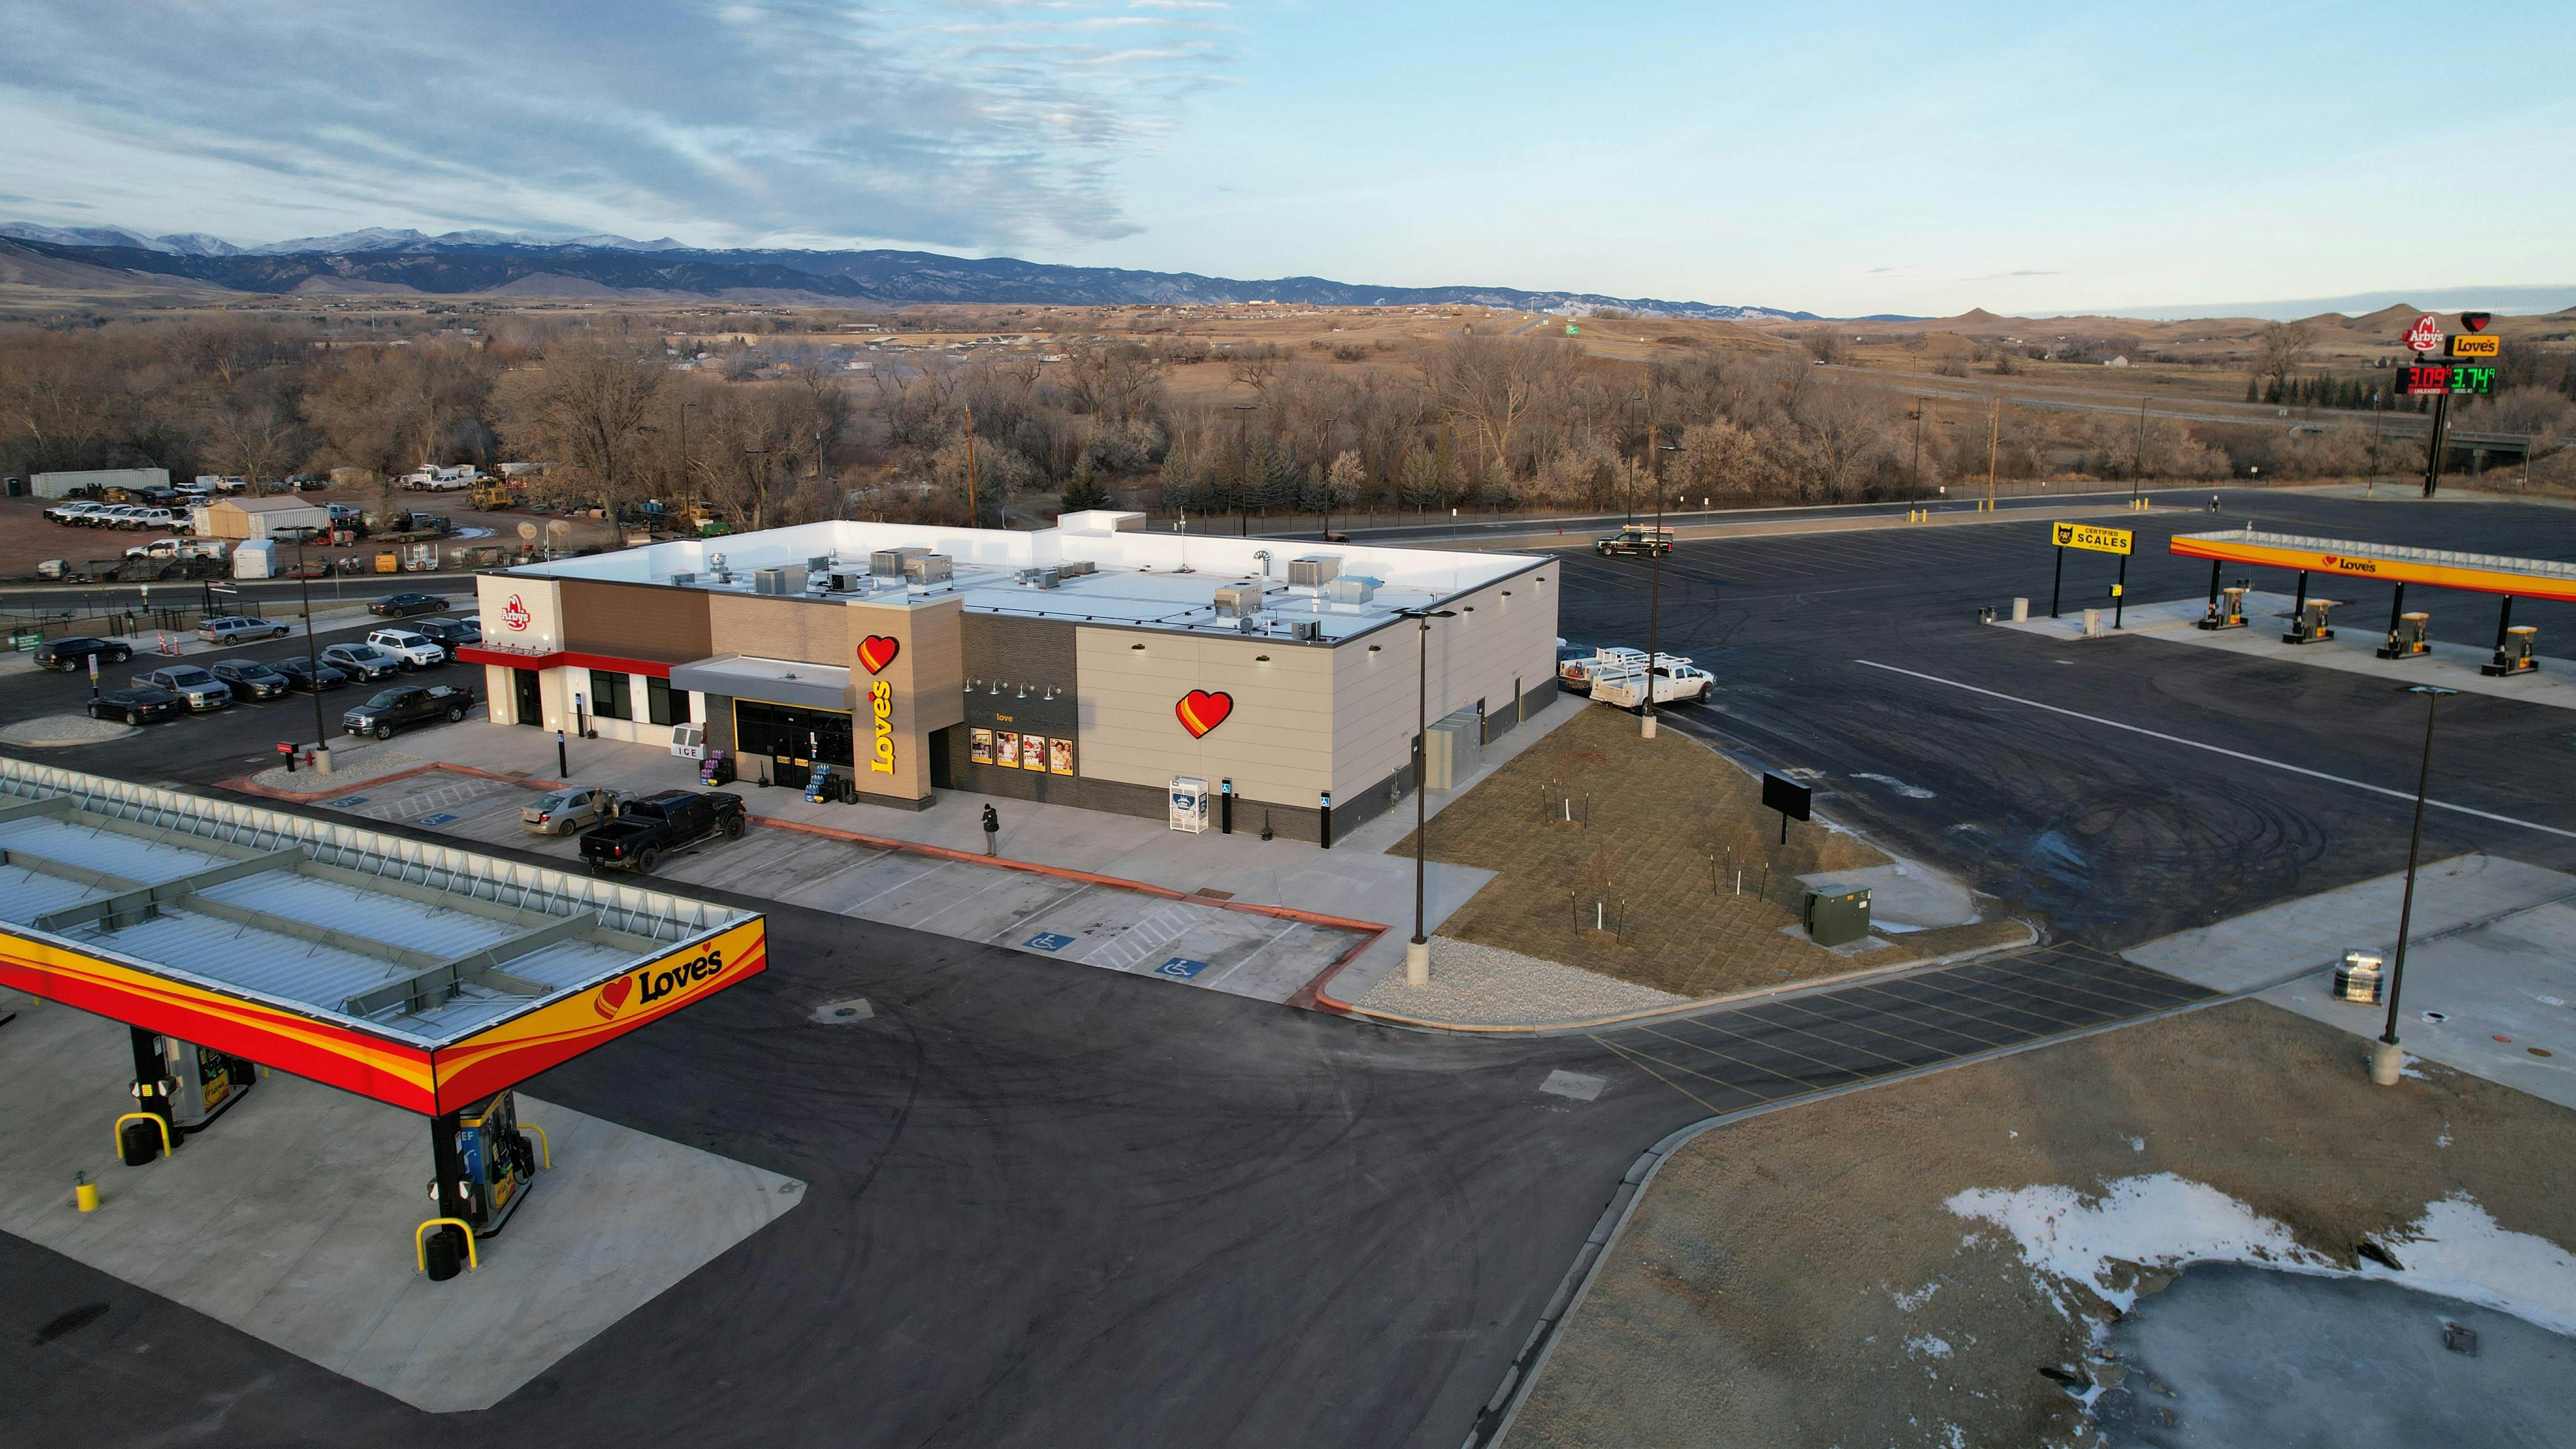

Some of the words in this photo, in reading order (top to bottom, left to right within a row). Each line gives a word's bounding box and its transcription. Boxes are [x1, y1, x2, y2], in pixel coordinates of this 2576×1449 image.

[2409, 330, 2443, 344] Arby's
[2060, 531, 2070, 539] CAT
[2085, 528, 2118, 536] CERTIFIED
[2077, 533, 2127, 547] SCALES
[502, 609, 529, 624] Arby's
[996, 713, 1013, 722] love
[679, 748, 697, 757] ICE
[461, 1131, 474, 1141] EF
